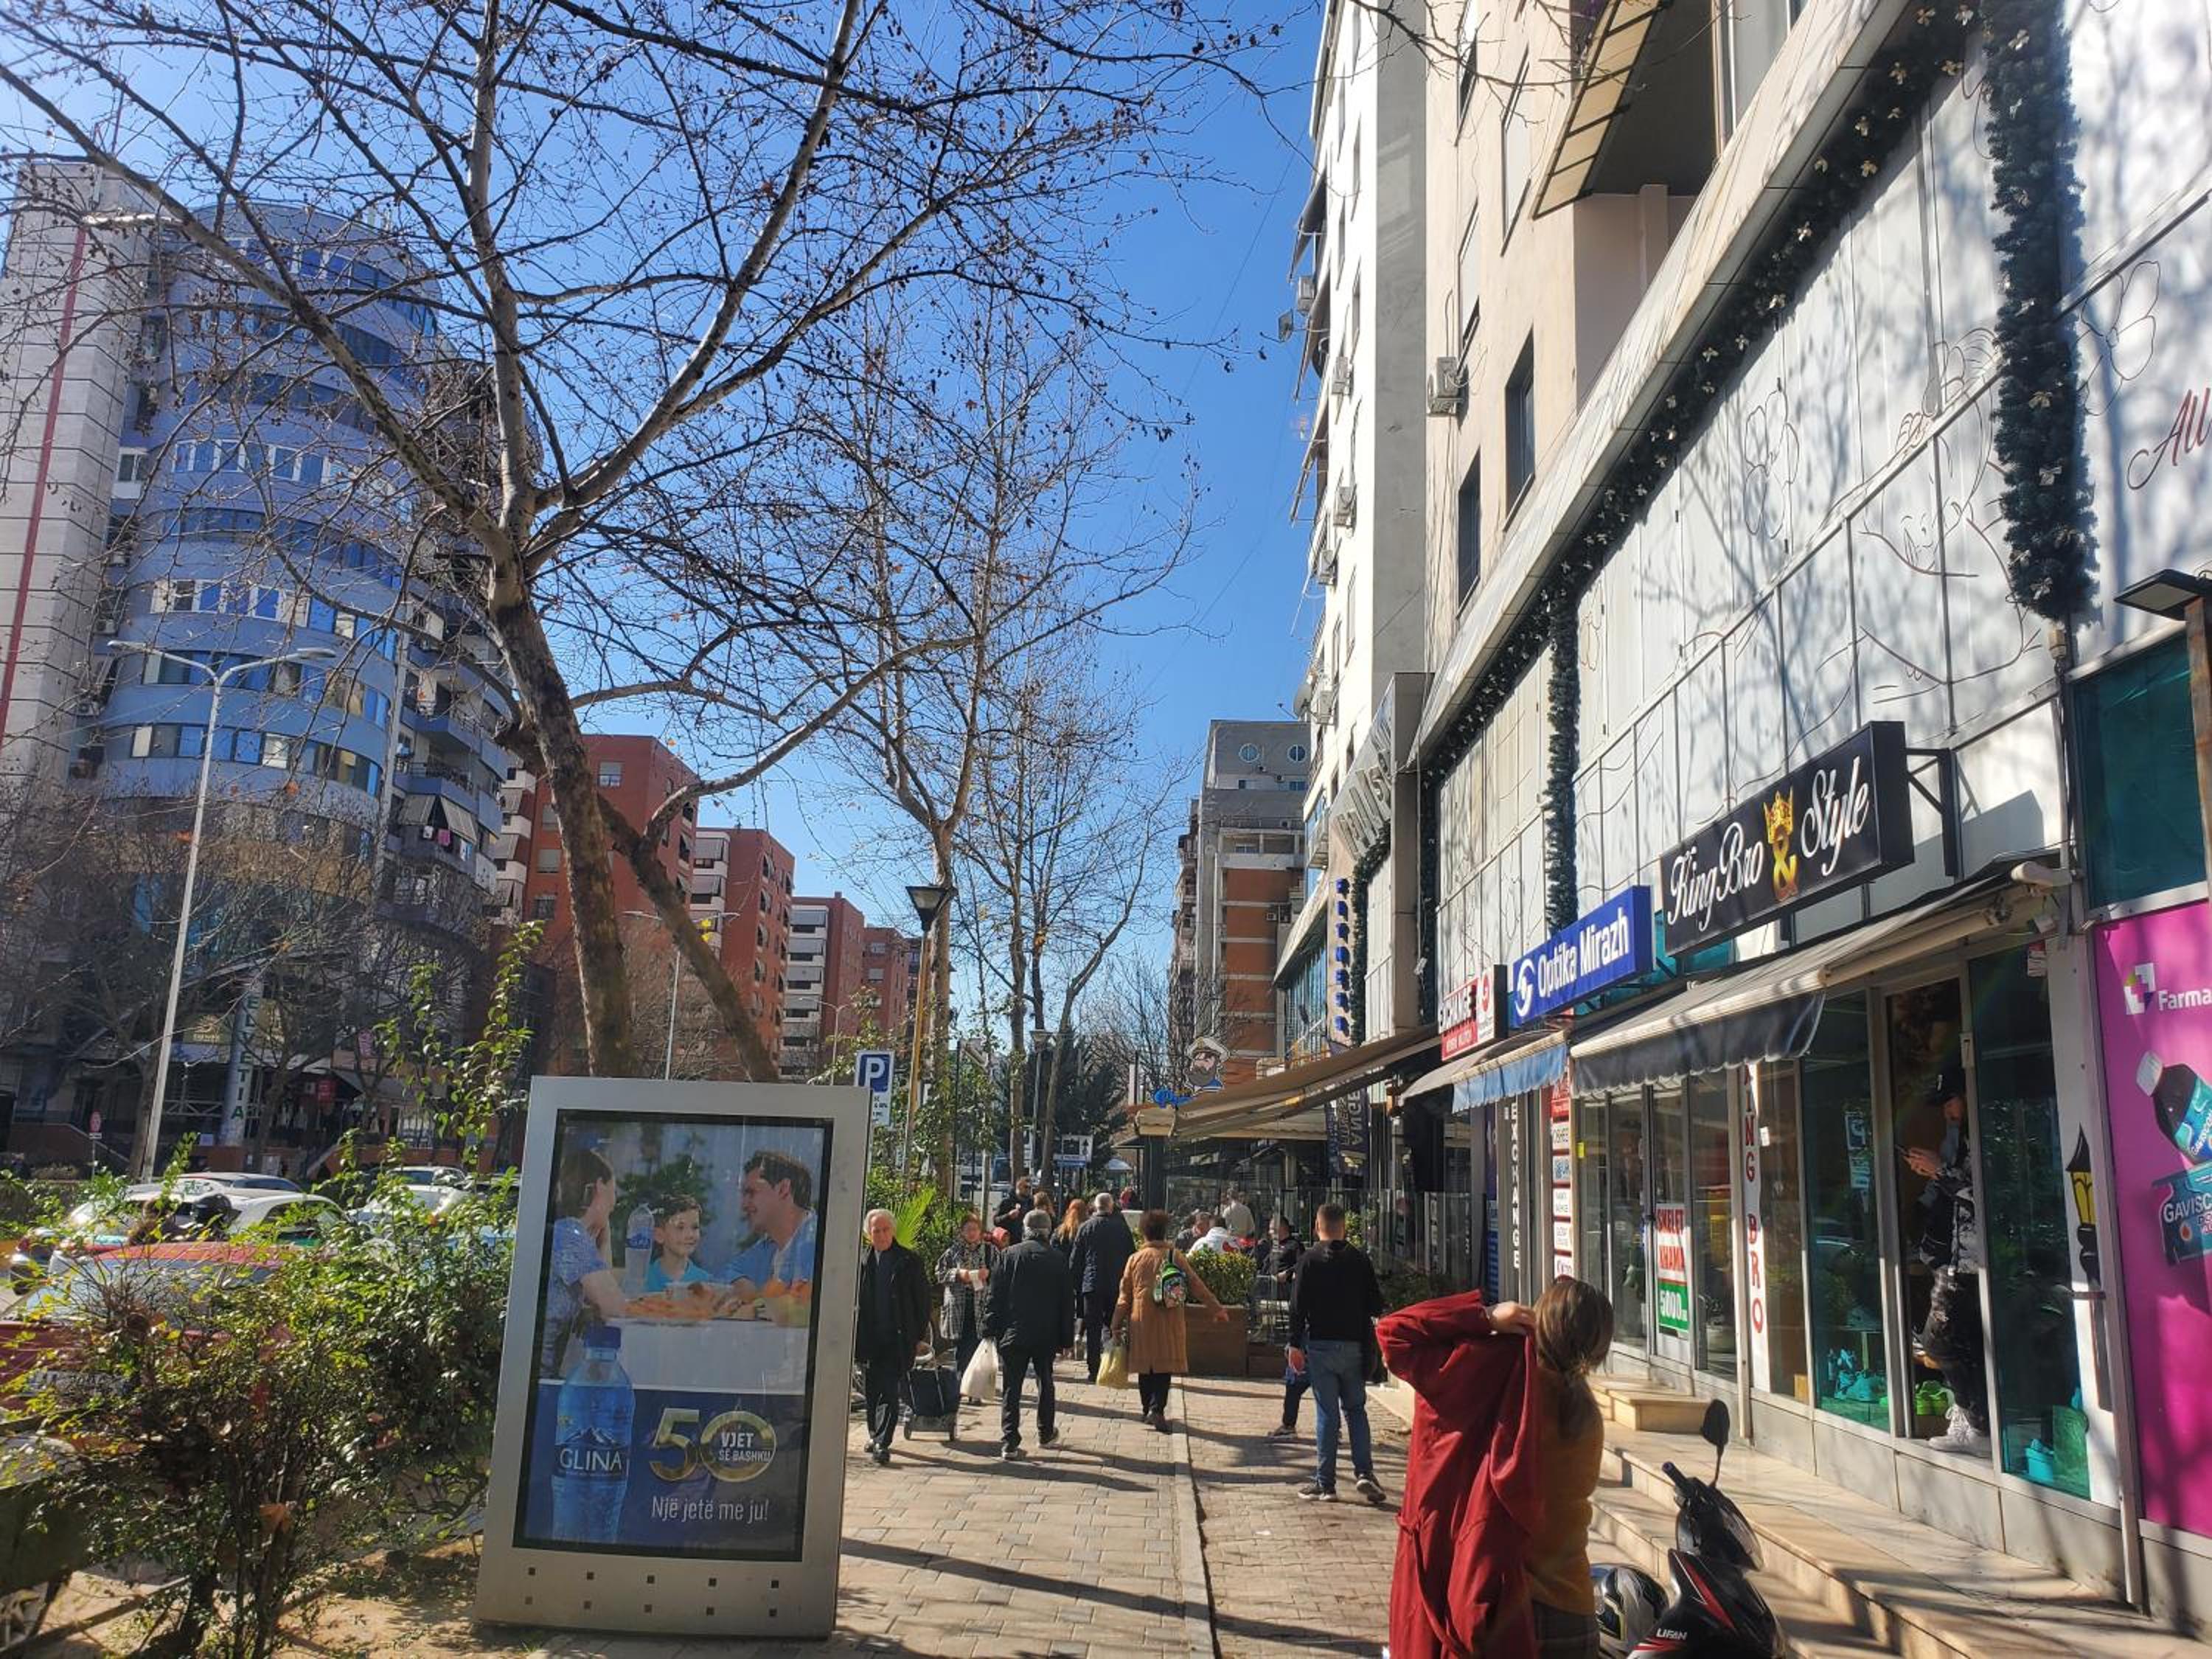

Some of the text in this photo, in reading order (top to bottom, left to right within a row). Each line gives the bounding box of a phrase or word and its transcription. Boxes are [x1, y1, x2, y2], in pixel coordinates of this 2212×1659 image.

[1801, 756, 1868, 876] Style
[1537, 906, 1630, 998] Optika Mirazh
[2158, 989, 2212, 1012] Farma
[864, 1057, 886, 1090] P
[1511, 1102, 1520, 1269] EXCHANGE
[1747, 1213, 1764, 1334] BRO
[649, 1408, 776, 1483] 50
[720, 1432, 754, 1448] VJET
[560, 1448, 622, 1471] GLINA
[731, 1450, 771, 1462] BASHKU
[651, 1495, 769, 1524] Një jetë me ju!
[1656, 1627, 1688, 1640] LIFAN
